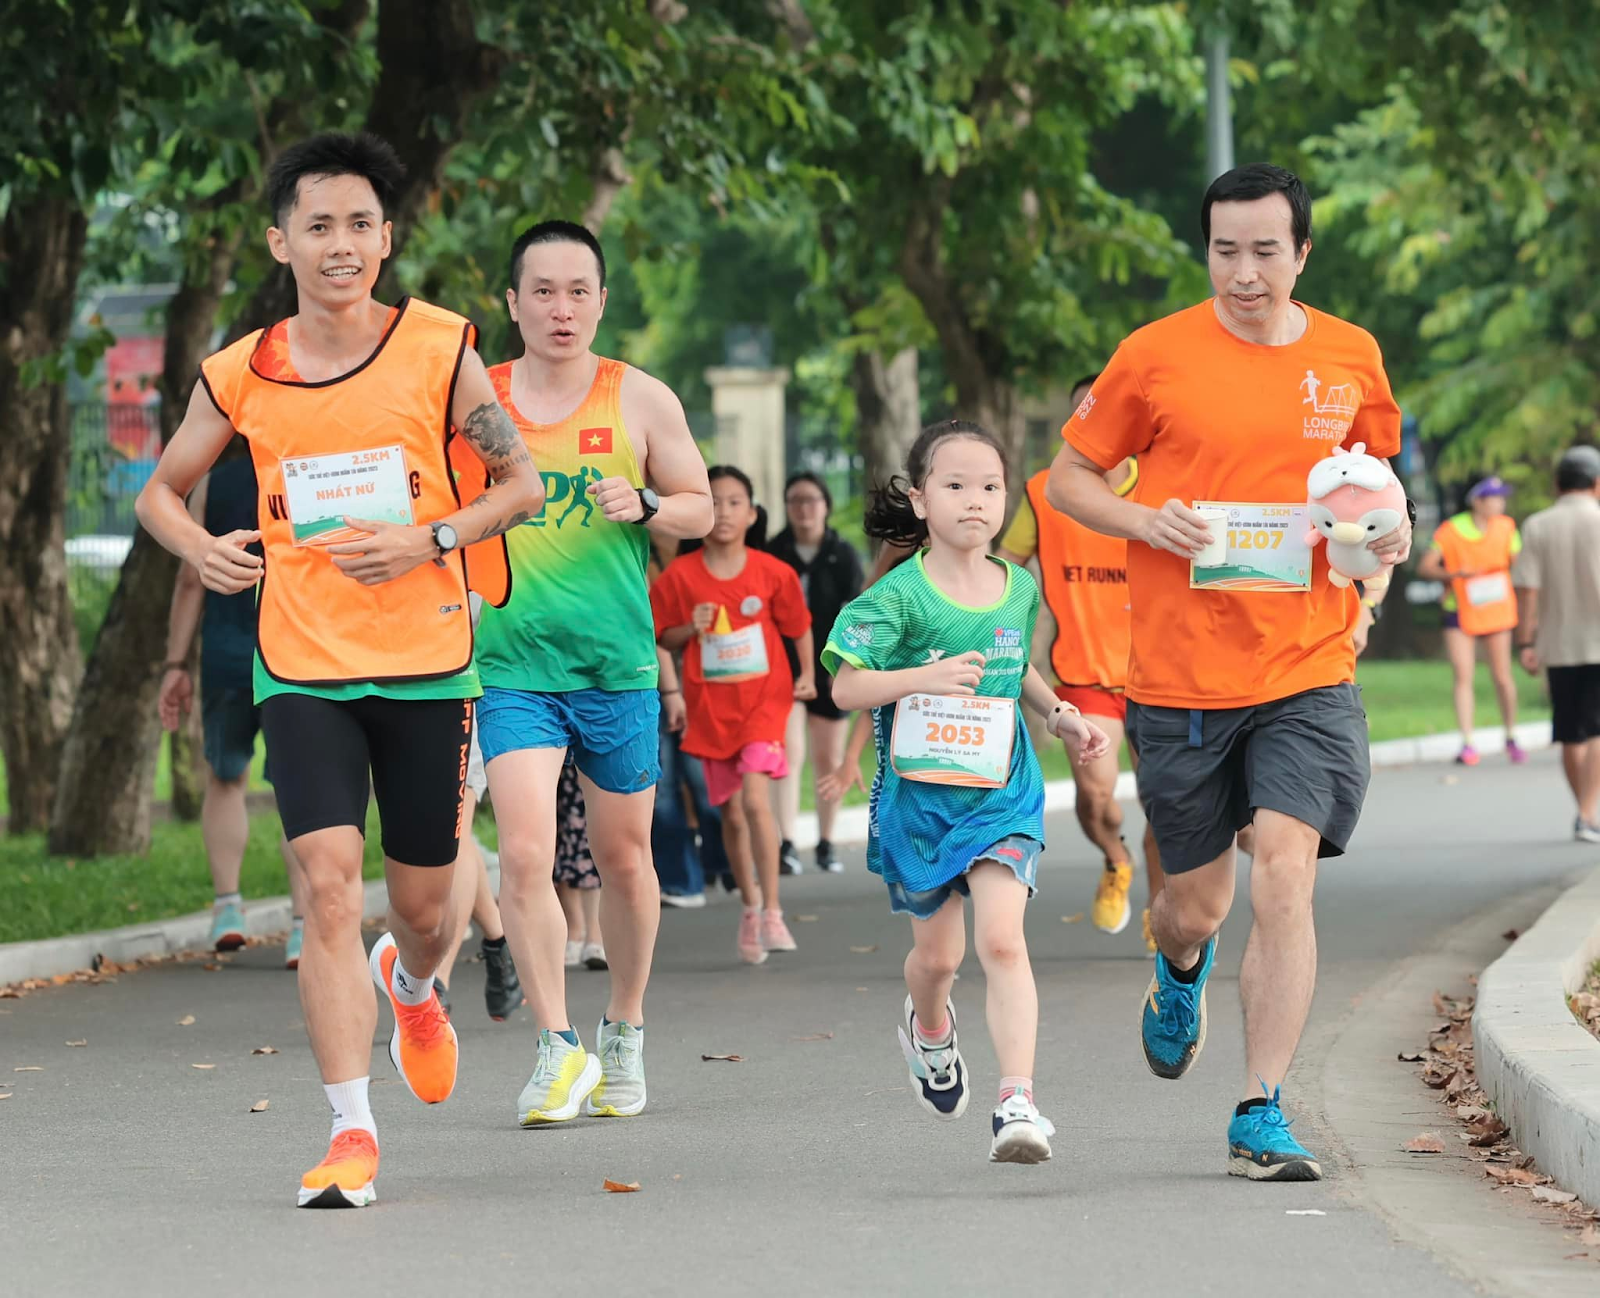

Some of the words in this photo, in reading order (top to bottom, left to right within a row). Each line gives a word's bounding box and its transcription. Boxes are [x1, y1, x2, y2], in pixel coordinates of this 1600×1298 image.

[352, 450, 390, 465] 2.5KM
[1262, 508, 1291, 517] 2.5KM
[1227, 530, 1284, 550] 1207
[1087, 566, 1127, 583] RUNN
[961, 700, 990, 710] 2.5KM
[925, 722, 985, 746] 2053
